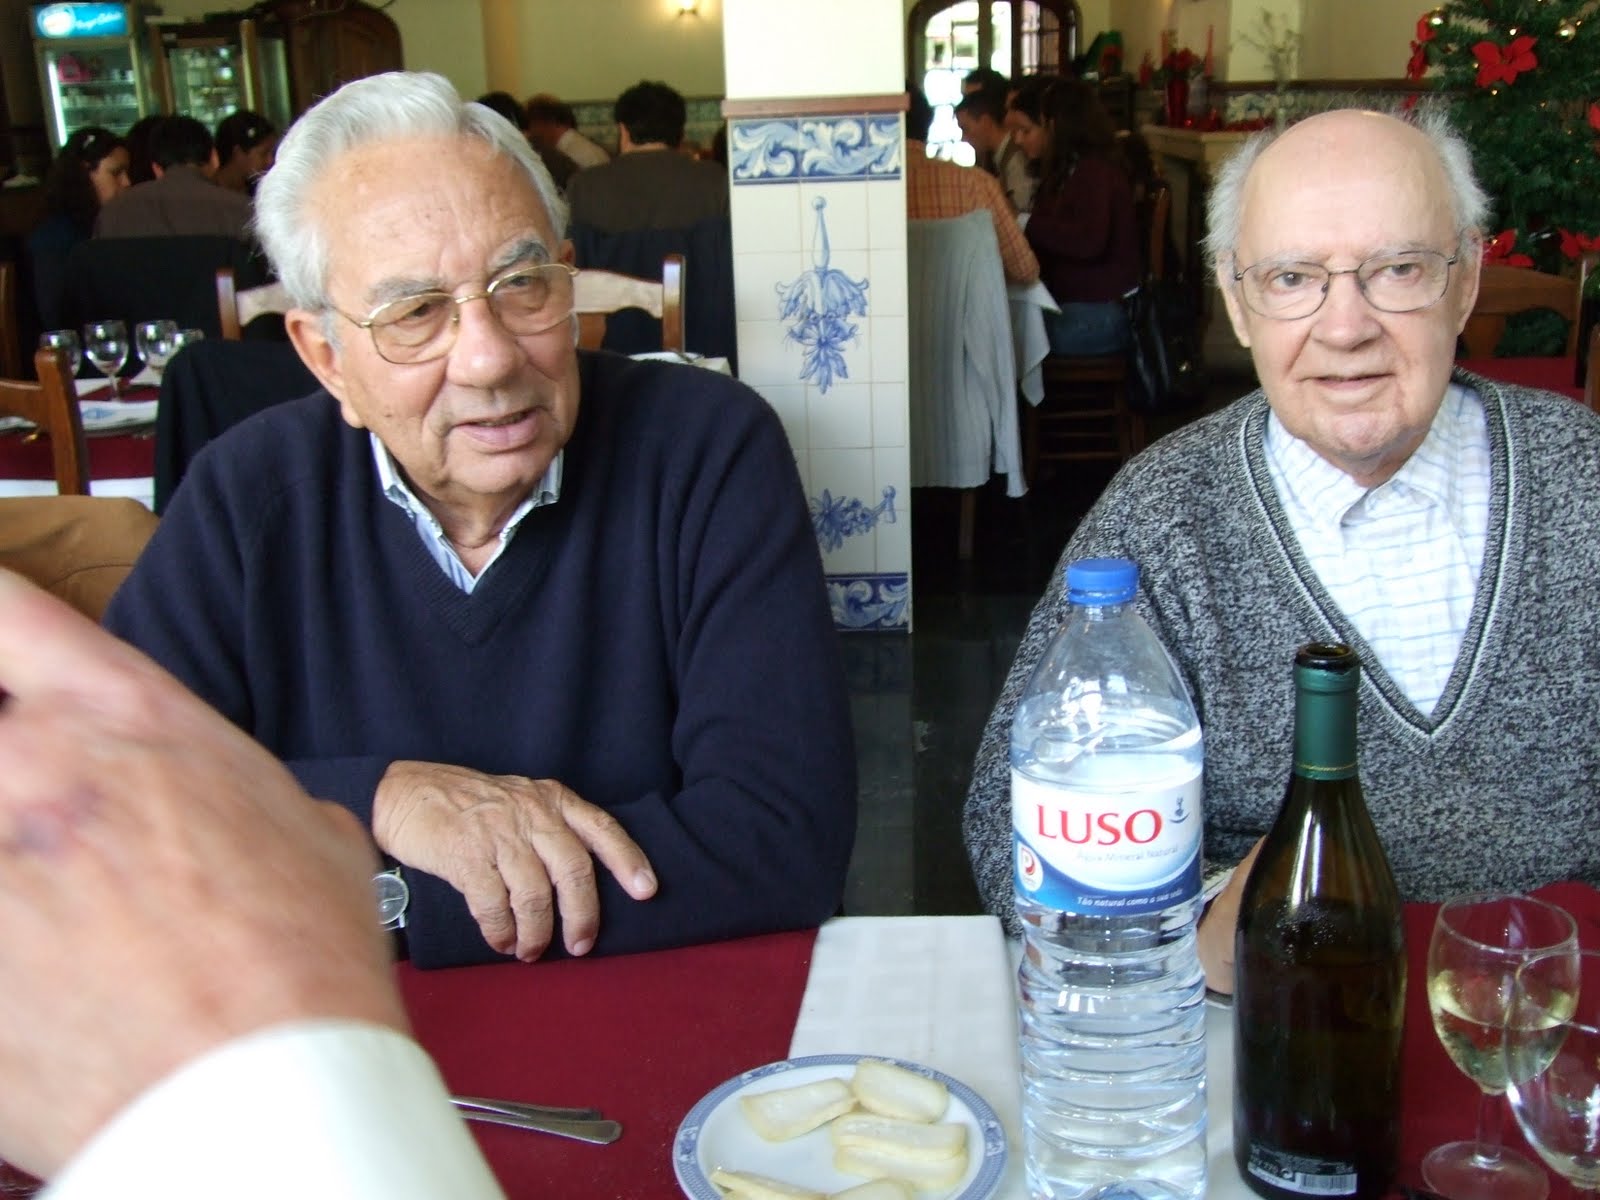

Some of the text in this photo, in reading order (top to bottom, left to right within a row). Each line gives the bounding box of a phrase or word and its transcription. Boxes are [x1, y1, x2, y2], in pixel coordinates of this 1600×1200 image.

[1037, 804, 1163, 845] LUSO
[1077, 896, 1093, 906] Tão
[1093, 897, 1126, 907] natural
[1126, 897, 1149, 906] como
